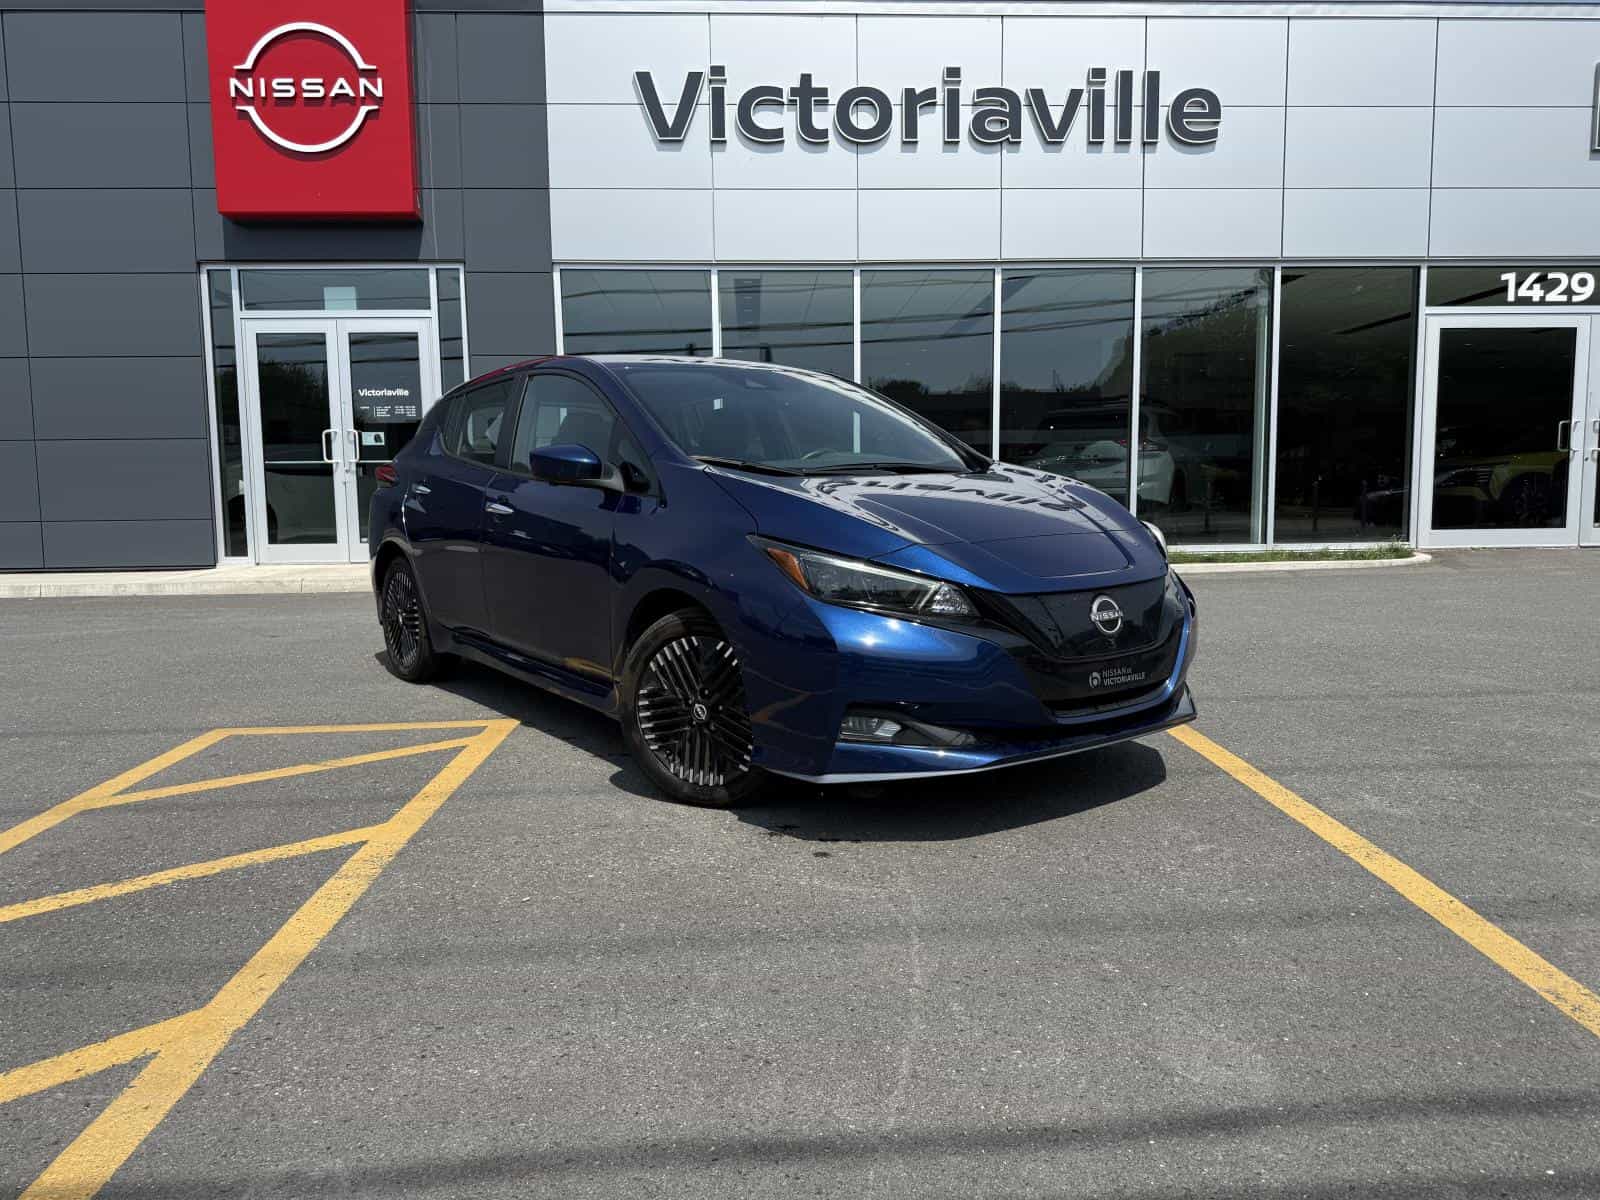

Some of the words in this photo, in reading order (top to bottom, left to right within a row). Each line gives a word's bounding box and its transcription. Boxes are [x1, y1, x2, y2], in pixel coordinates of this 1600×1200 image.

[229, 77, 383, 98] NISSAN
[632, 65, 1222, 147] Victoriaville
[1500, 272, 1595, 302] 1429
[358, 388, 409, 397] Victoriaville
